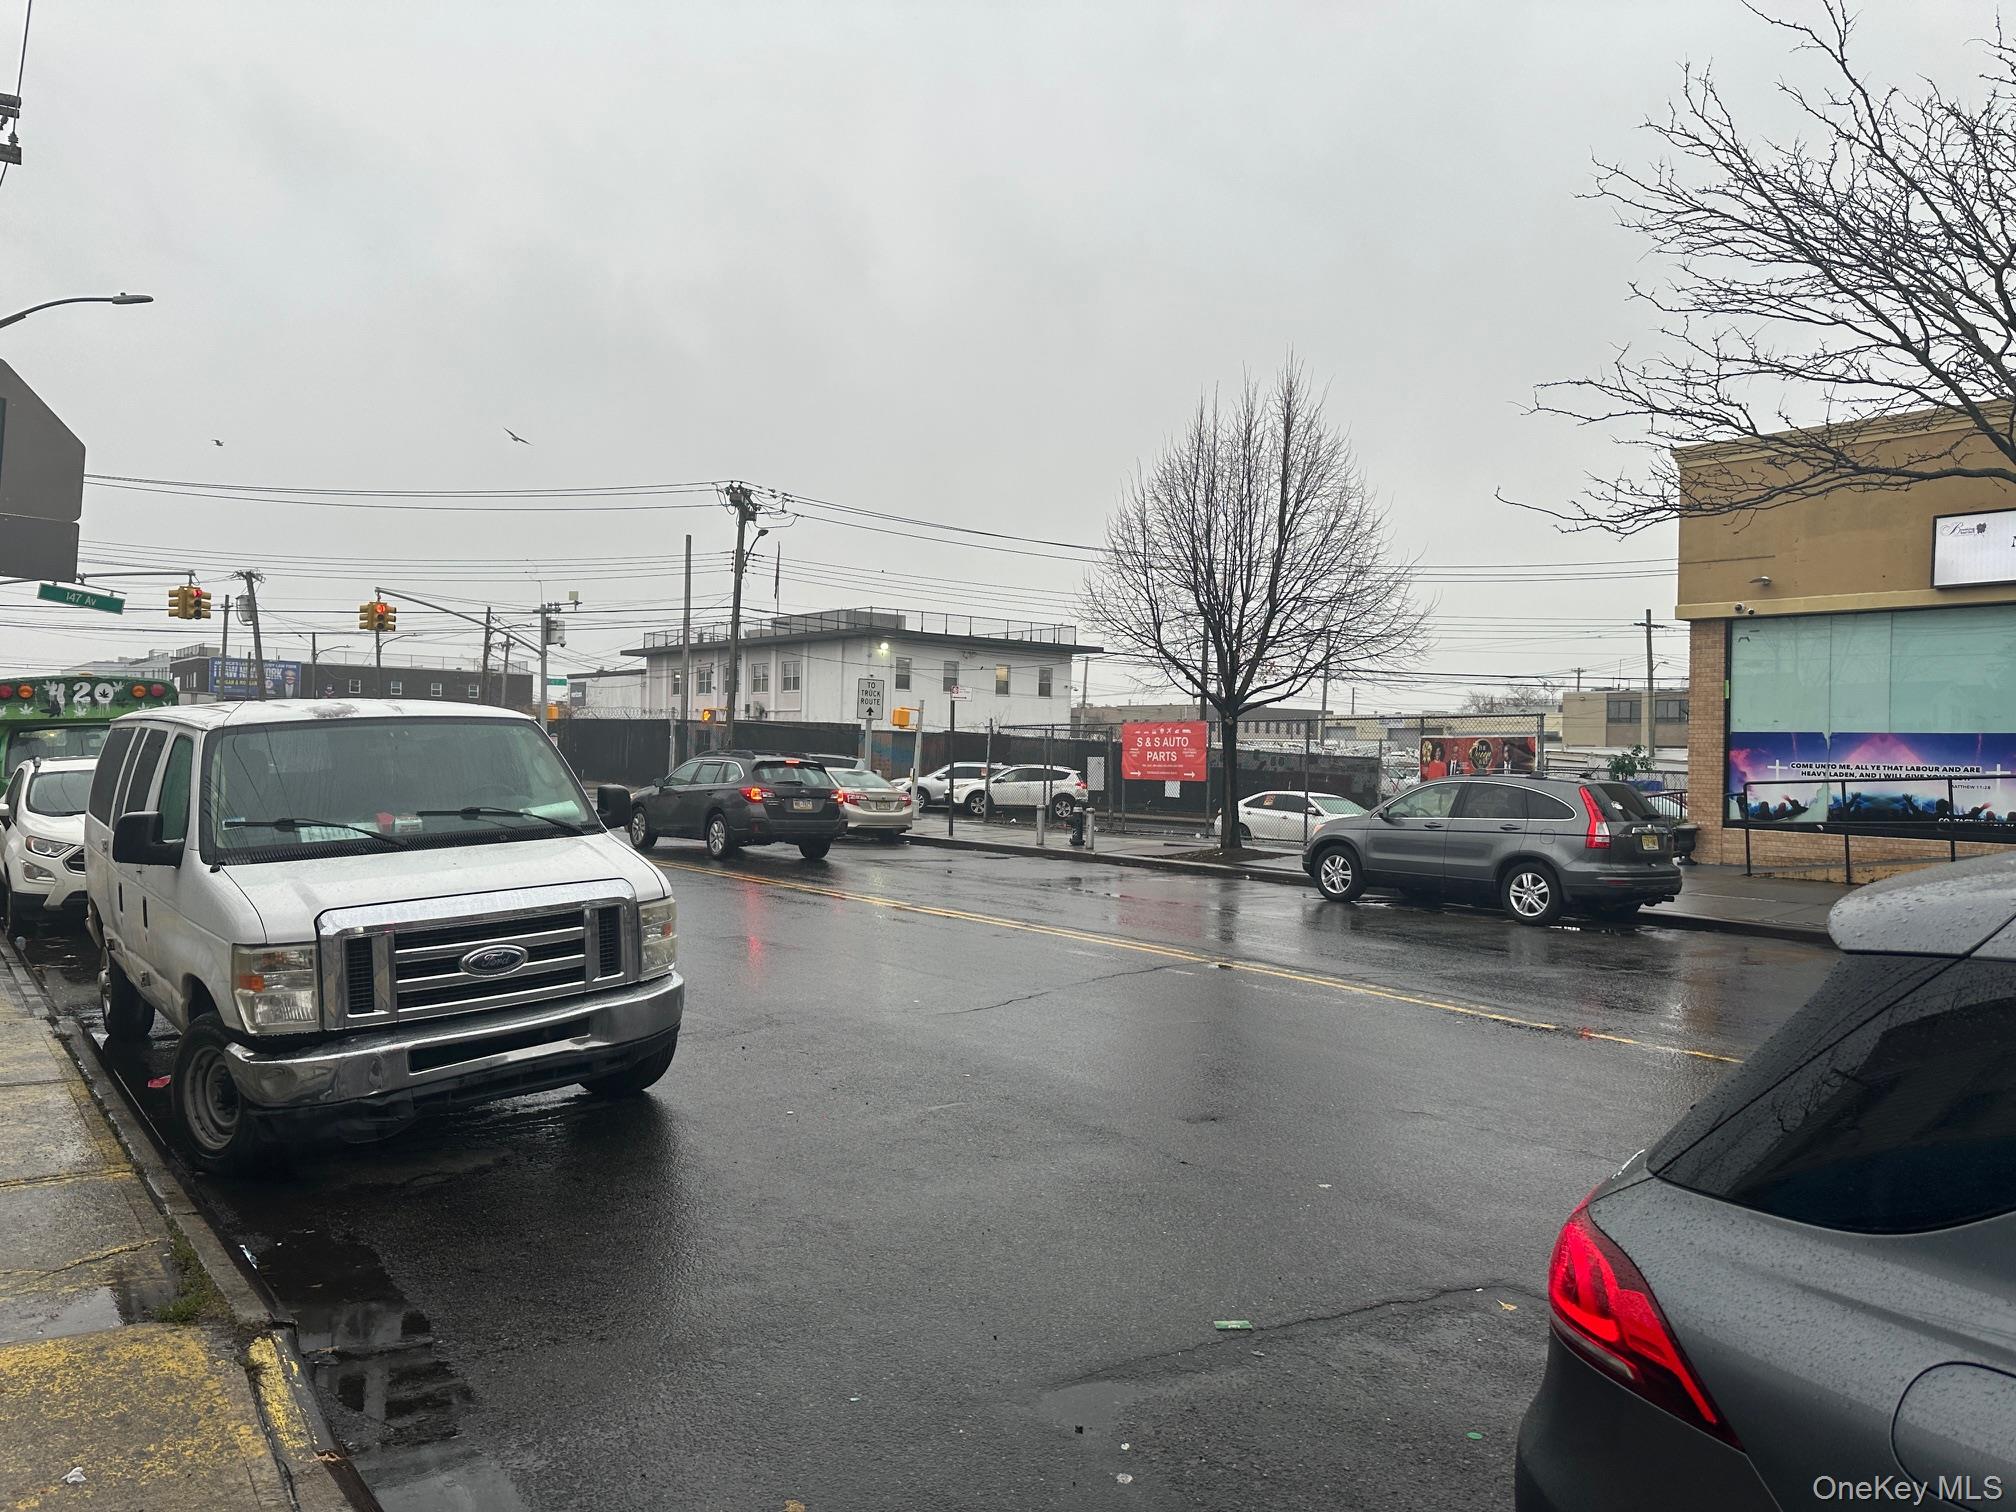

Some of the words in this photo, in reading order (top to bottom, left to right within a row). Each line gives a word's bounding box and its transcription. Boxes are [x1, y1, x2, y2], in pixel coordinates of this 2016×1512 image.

[65, 592, 82, 603] 147
[84, 596, 97, 606] Av
[49, 682, 115, 705] 420
[1136, 737, 1143, 747] S
[1145, 737, 1152, 747] &
[1153, 737, 1161, 747] S
[1162, 737, 1189, 747] AUTO
[1146, 751, 1178, 762] PARTS
[1905, 765, 1940, 773] LABOUR
[1829, 771, 1858, 779] LADEN,
[481, 951, 511, 967] Ford
